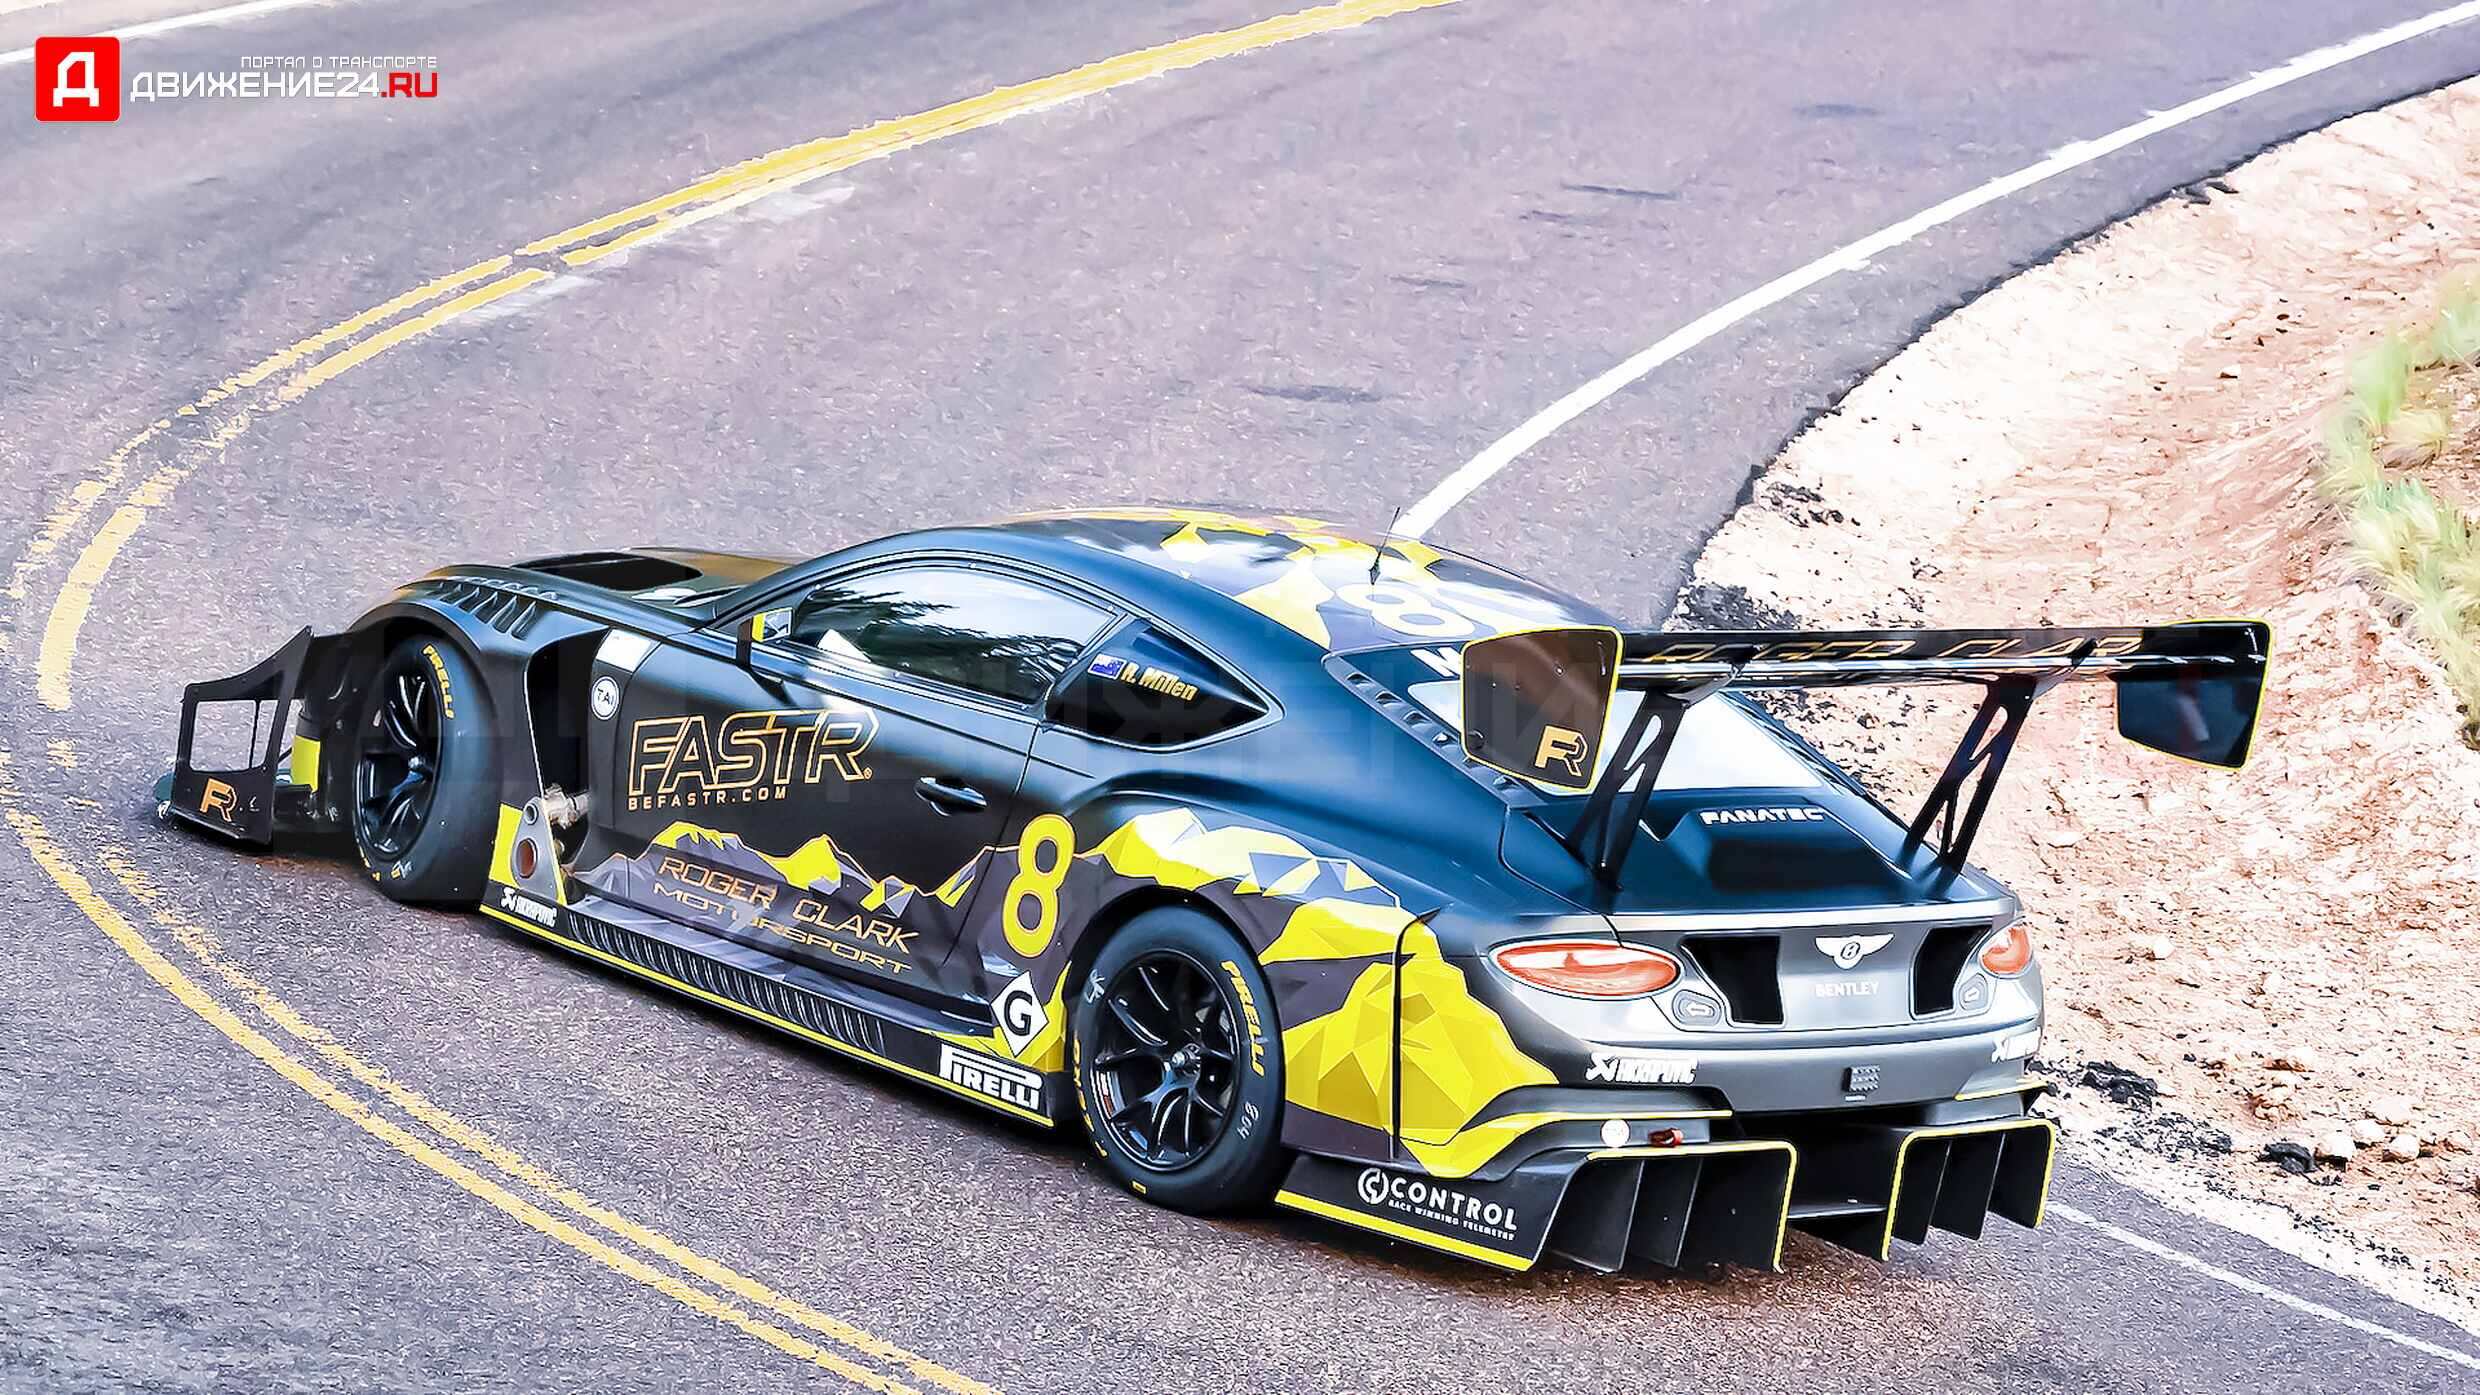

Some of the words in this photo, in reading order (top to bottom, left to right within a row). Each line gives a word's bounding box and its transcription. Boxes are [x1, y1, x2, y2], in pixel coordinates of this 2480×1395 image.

[1138, 666, 1199, 701] Millen
[628, 786, 787, 812] BEFASTR.COM
[1699, 806, 1826, 825] FANATEC
[657, 855, 779, 912] ROGER
[791, 897, 920, 955] CLARK
[1002, 813, 1076, 958] 8
[1003, 989, 1034, 1037] G
[1815, 981, 1880, 998] BENTLEY
[1220, 960, 1266, 1077] PIRELLI
[939, 1042, 1043, 1111] PIRELLI
[1390, 1176, 1519, 1232] CONTROL
